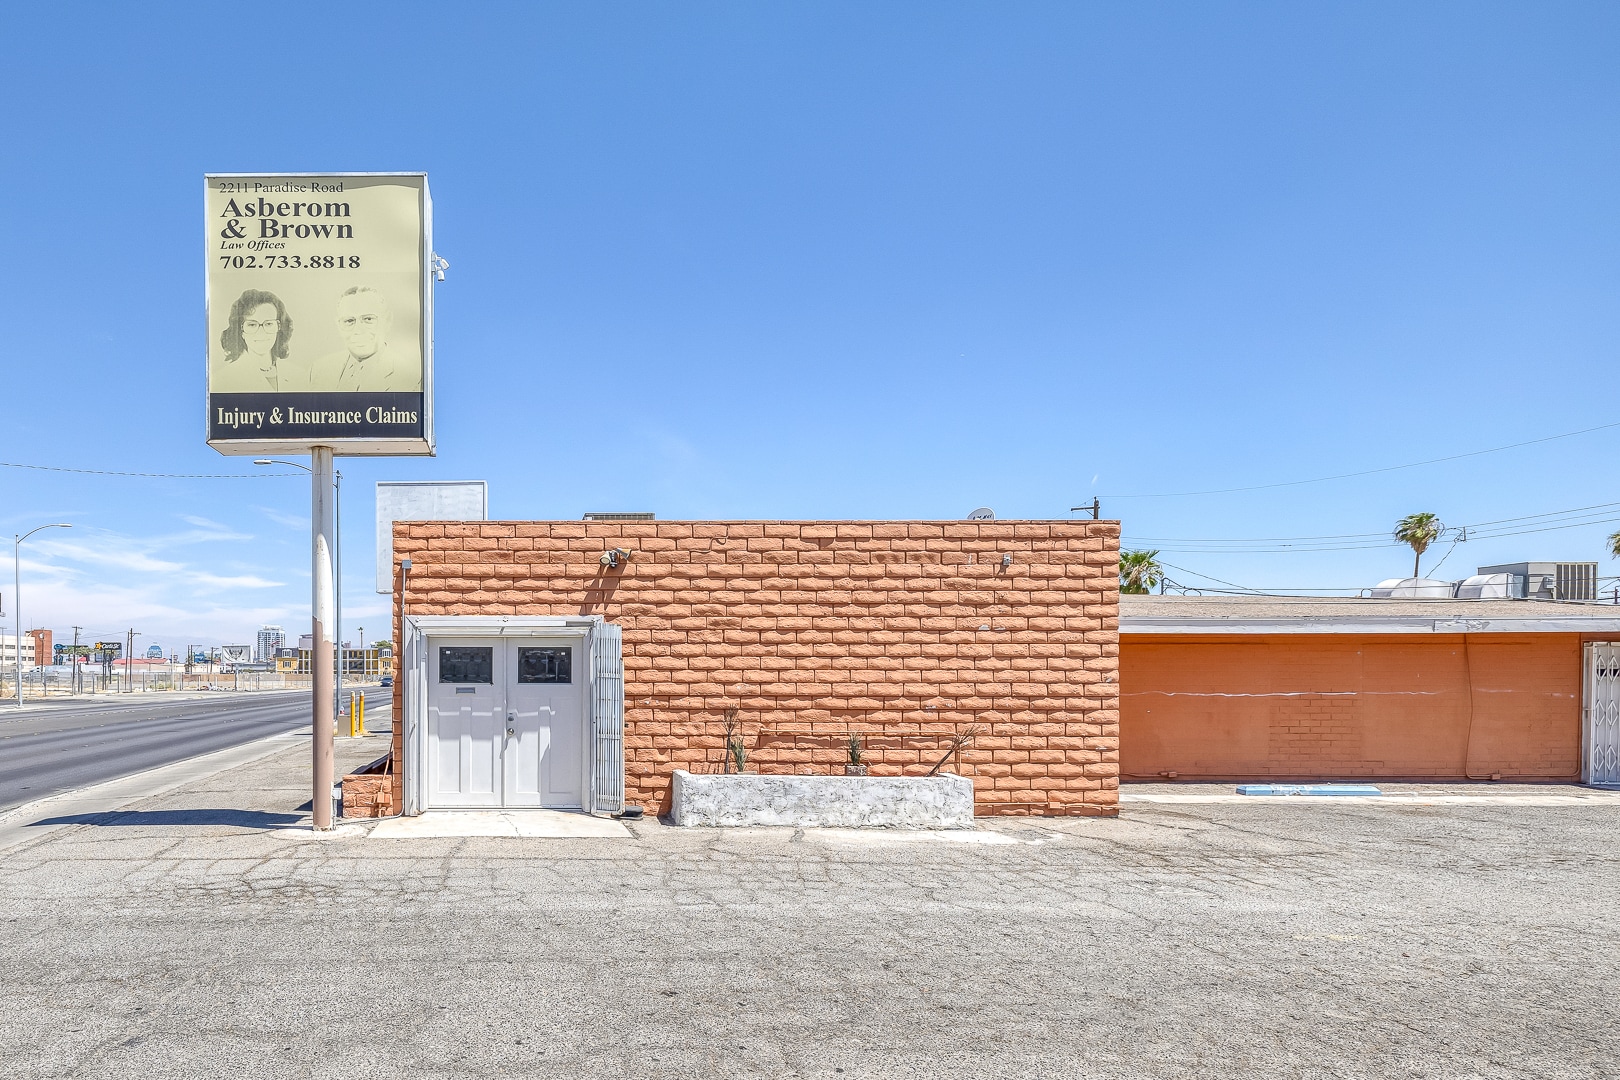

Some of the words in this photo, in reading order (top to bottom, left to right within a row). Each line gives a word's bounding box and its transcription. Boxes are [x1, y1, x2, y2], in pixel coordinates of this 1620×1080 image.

[219, 182, 248, 193] 2211
[254, 182, 307, 193] Paradise
[311, 182, 344, 193] Road
[220, 197, 351, 218] Asberom
[220, 218, 247, 239] &
[257, 218, 354, 239] Brown
[220, 241, 244, 250] Law
[247, 240, 286, 251] Offices
[219, 255, 361, 269] 702.733.8818
[217, 407, 265, 429] Injury
[269, 406, 283, 425] &
[287, 407, 361, 424] Insurance
[365, 406, 418, 424] Claims
